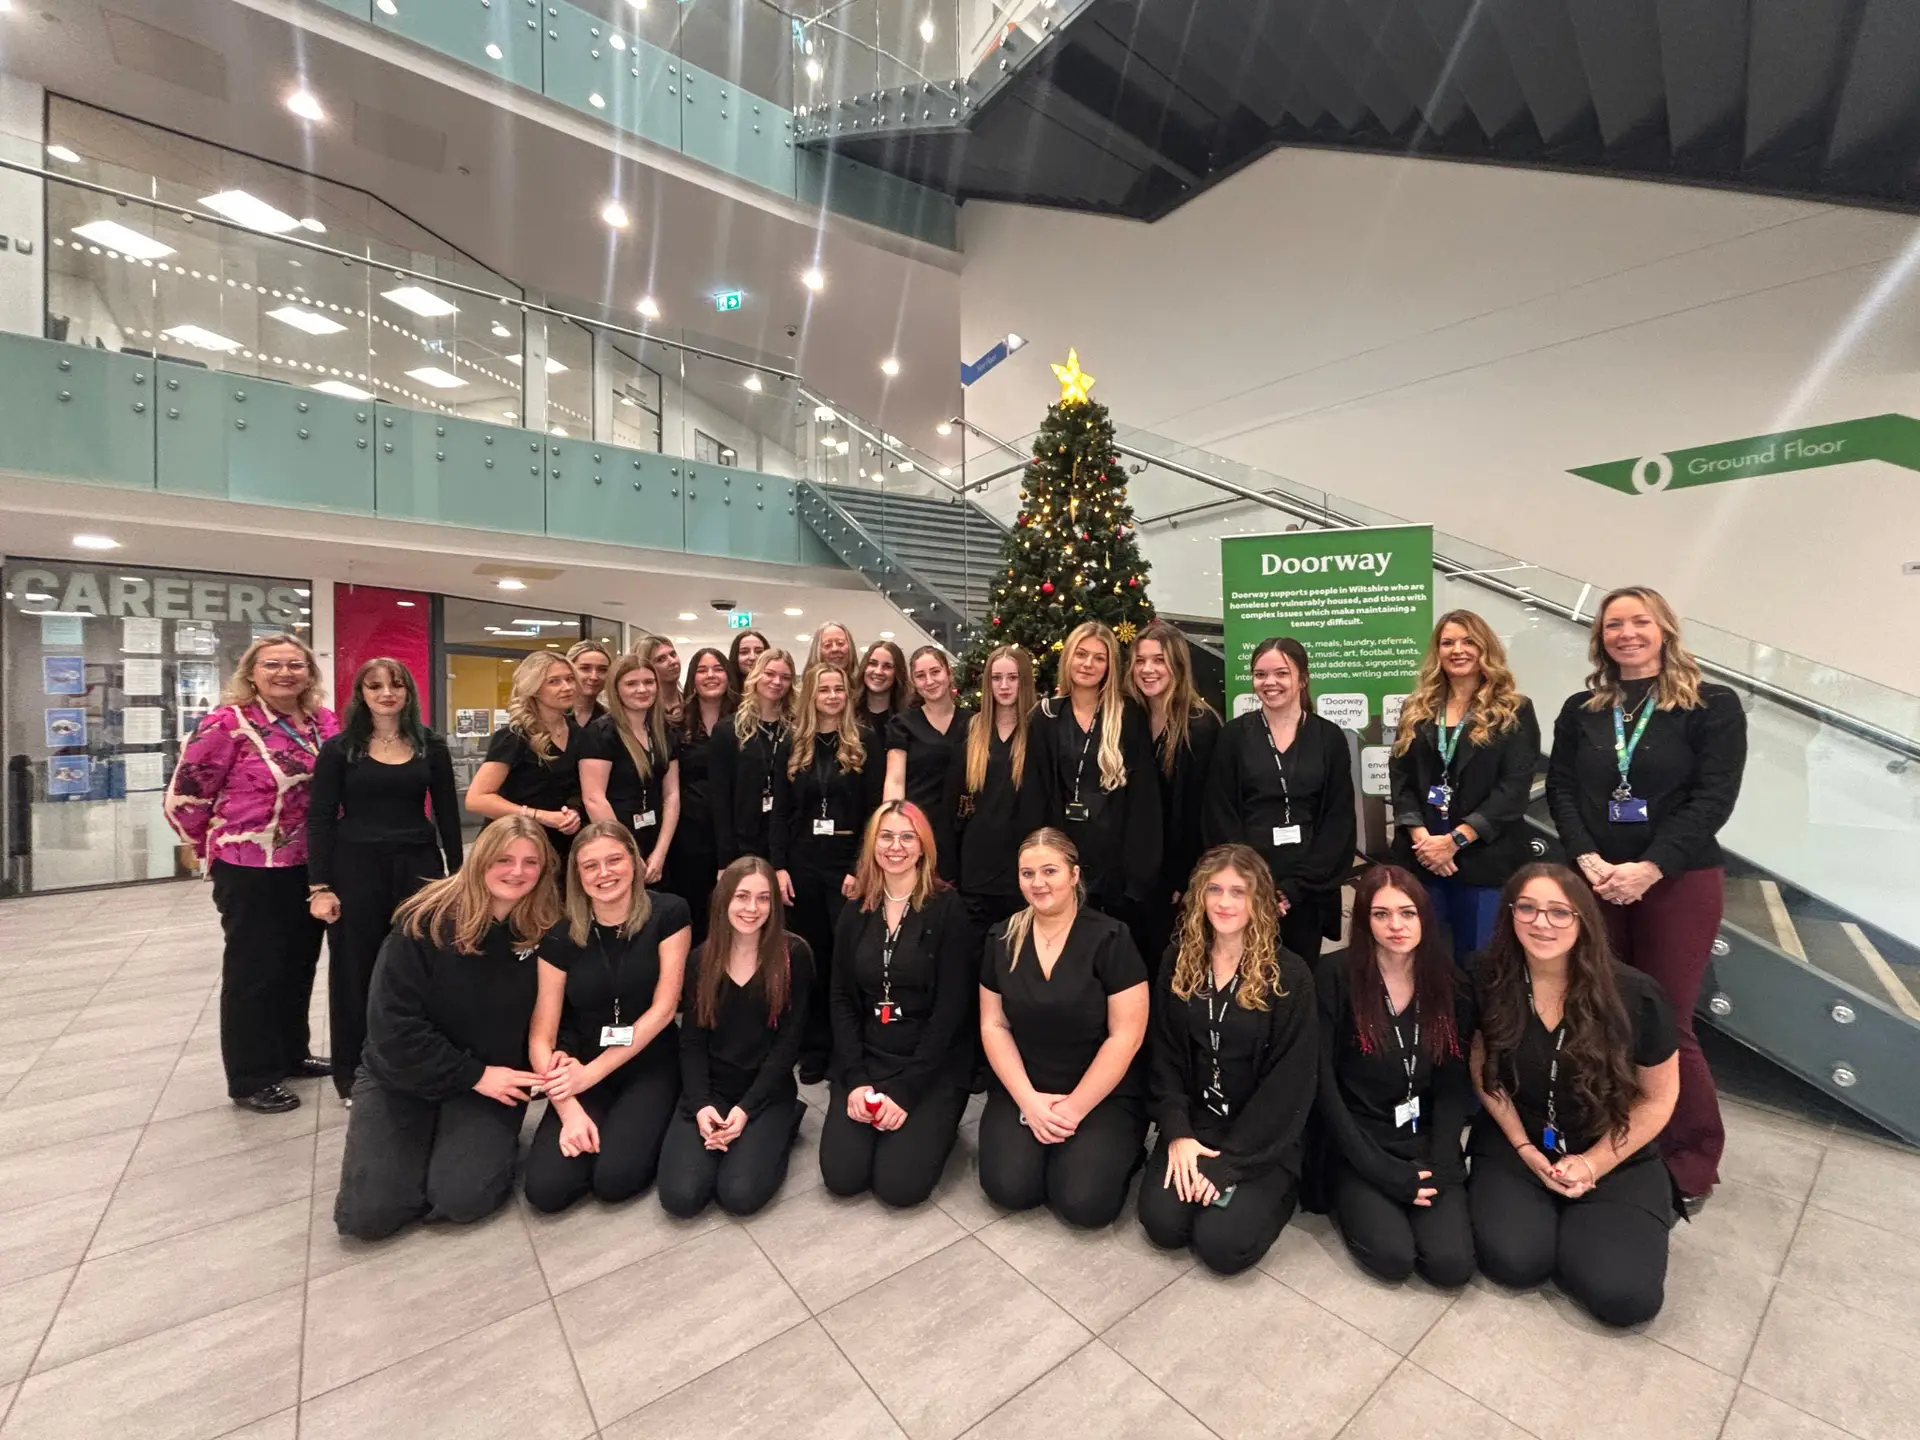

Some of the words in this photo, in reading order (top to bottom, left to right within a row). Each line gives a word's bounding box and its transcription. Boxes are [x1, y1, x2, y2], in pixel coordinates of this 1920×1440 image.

[1688, 444, 1776, 475] Ground
[1784, 439, 1848, 460] Floor
[1261, 552, 1393, 577] Doorway
[1231, 591, 1269, 600] Doorway
[1270, 588, 1308, 598] supports
[1309, 586, 1338, 596] people
[1339, 586, 1348, 594] in
[1348, 584, 1390, 593] Wiltshire
[1391, 583, 1409, 591] who
[10, 569, 304, 626] CAREERS
[1229, 601, 1269, 610] homeless
[1280, 598, 1326, 607] vulnerably
[1326, 596, 1361, 605] housed,
[1362, 595, 1379, 603] and
[1407, 593, 1427, 601] with
[1241, 611, 1275, 620] complex
[1276, 610, 1303, 618] issues
[1304, 608, 1330, 616] which
[1331, 607, 1355, 615] make
[1356, 605, 1409, 614] maintaining
[1290, 620, 1325, 628] tenancy
[1326, 617, 1364, 626] difficult.
[1242, 642, 1256, 650] We
[1315, 639, 1342, 648] meals,
[1343, 638, 1376, 648] laundry,
[1315, 649, 1342, 658] music,
[1343, 649, 1359, 657] art,
[1360, 647, 1395, 656] football,
[1328, 660, 1364, 668] address,
[1309, 671, 1350, 681] elephone,
[1352, 670, 1382, 679] writing
[1382, 669, 1399, 677] and
[1349, 709, 1363, 717] my
[1370, 772, 1387, 780] and
